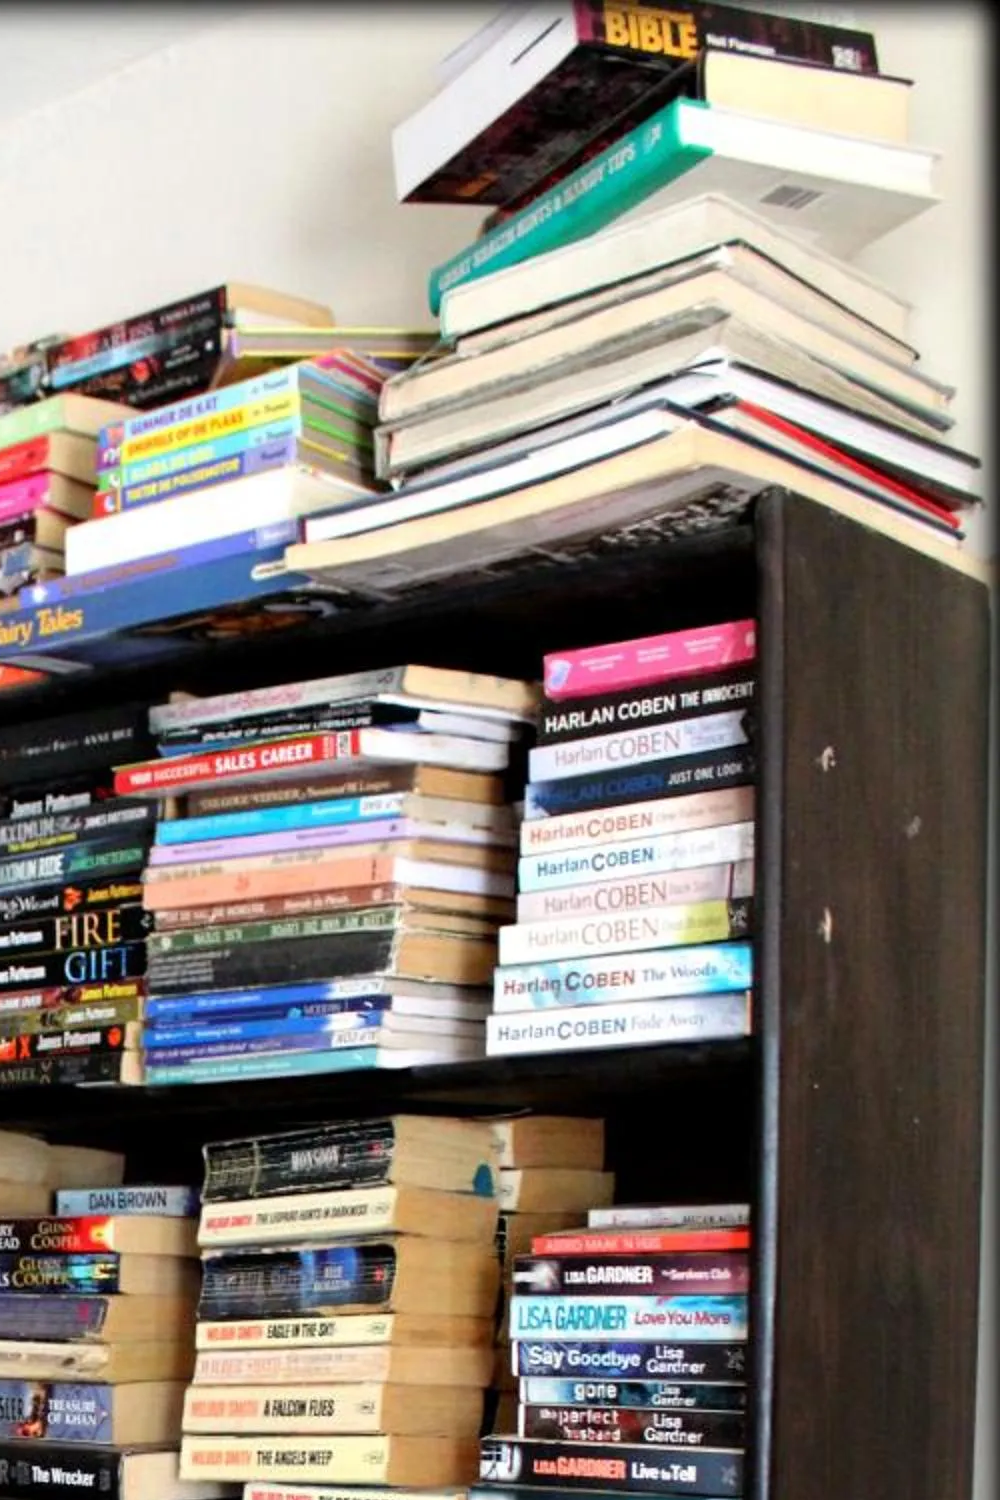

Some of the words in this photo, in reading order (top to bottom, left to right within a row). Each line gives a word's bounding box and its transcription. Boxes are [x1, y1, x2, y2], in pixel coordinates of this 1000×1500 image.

[603, 10, 698, 59] BIBLE
[36, 607, 84, 637] Tales
[545, 706, 614, 733] HARLAN
[618, 692, 676, 720] COBEN
[680, 690, 700, 707] THE
[702, 681, 755, 704] INNOCENT
[215, 751, 257, 775] SALES
[260, 742, 314, 769] CAREER
[555, 741, 603, 768] Harlan
[605, 728, 682, 762] COBEN
[668, 768, 692, 786] JUST
[695, 766, 715, 781] ONE
[717, 763, 744, 778] LOOK
[530, 821, 586, 845] Harlan
[587, 812, 655, 839] COBEN
[537, 857, 590, 878] Harlan
[591, 847, 655, 873] COBEN
[544, 892, 592, 914] Harlan
[594, 880, 668, 911] COBEN
[55, 911, 122, 950] FIRE
[528, 927, 579, 949] Harlan
[581, 917, 660, 946] COBEN
[64, 947, 130, 983] GIFT
[504, 974, 562, 998] Harlan
[564, 969, 636, 993] COBEN
[641, 966, 668, 983] The
[670, 961, 719, 979] Woods
[497, 1020, 555, 1043] Harlan
[557, 1016, 627, 1039] COBEN
[630, 1013, 662, 1032] Fade
[89, 1192, 115, 1211] DAN
[117, 1190, 168, 1209] BROWN
[564, 1270, 585, 1284] LISA
[587, 1265, 654, 1285] GARDNER
[518, 1305, 551, 1331] LISA
[555, 1304, 627, 1331] GARDNER
[634, 1311, 666, 1326] Love
[667, 1309, 693, 1325] You
[695, 1312, 732, 1325] More
[528, 1348, 565, 1370] Say
[567, 1349, 641, 1369] Goodbye
[655, 1345, 684, 1359] Lisa
[646, 1358, 706, 1375] Gardner
[573, 1382, 617, 1401] gone
[651, 1394, 697, 1408] Gardner
[658, 1384, 681, 1396] Lisa
[64, 1412, 97, 1426] KHAN
[271, 1400, 308, 1418] FALCON
[308, 1399, 335, 1417] FLIES
[558, 1407, 620, 1426] perfect
[653, 1412, 683, 1430] Lisa
[563, 1427, 621, 1442] husband
[643, 1427, 704, 1445] Gardner
[257, 1450, 274, 1466] THE
[274, 1449, 308, 1466] ANGELS
[308, 1449, 333, 1466] WEEP
[31, 1465, 50, 1483] The
[51, 1467, 96, 1488] Wrecker
[556, 1457, 627, 1480] GARDNER
[631, 1462, 660, 1480] Live
[671, 1464, 697, 1483] Tell
